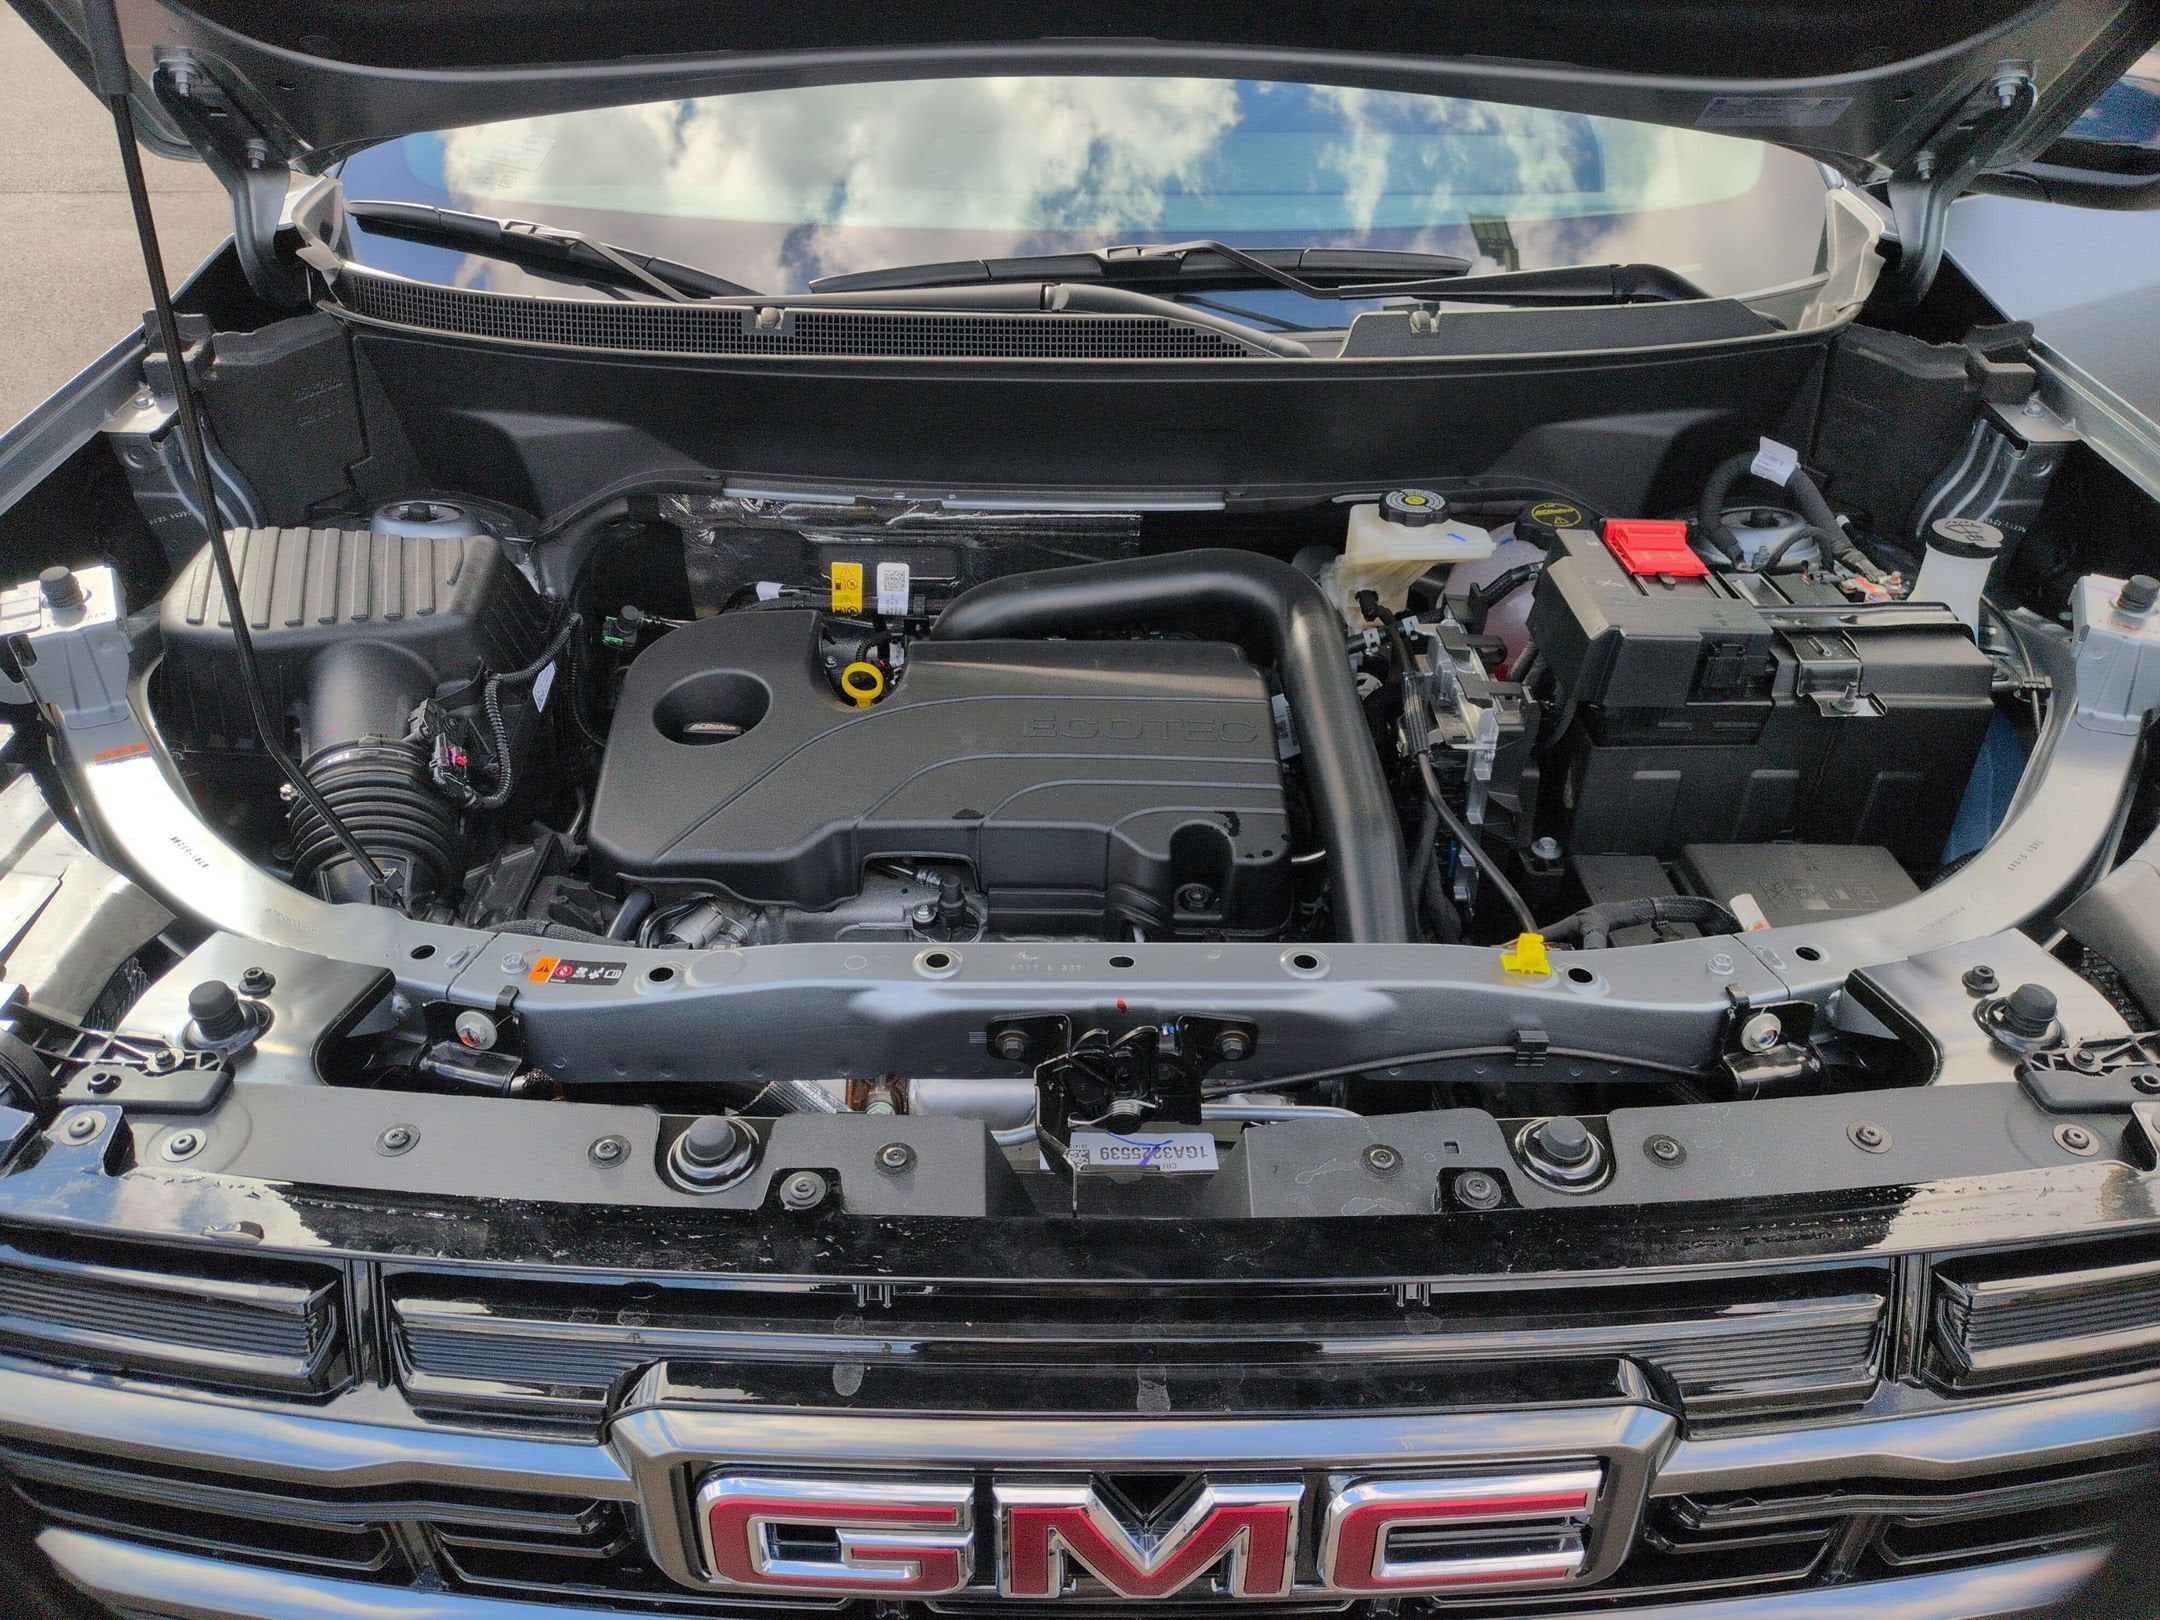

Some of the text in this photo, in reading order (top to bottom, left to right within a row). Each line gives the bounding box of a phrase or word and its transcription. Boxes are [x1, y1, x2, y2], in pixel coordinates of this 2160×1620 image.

[688, 723, 736, 731] ACDelco
[1024, 716, 1257, 743] ECOTEC
[1100, 1146, 1208, 1160] 1GA3225539
[692, 1471, 1602, 1598] GMC
